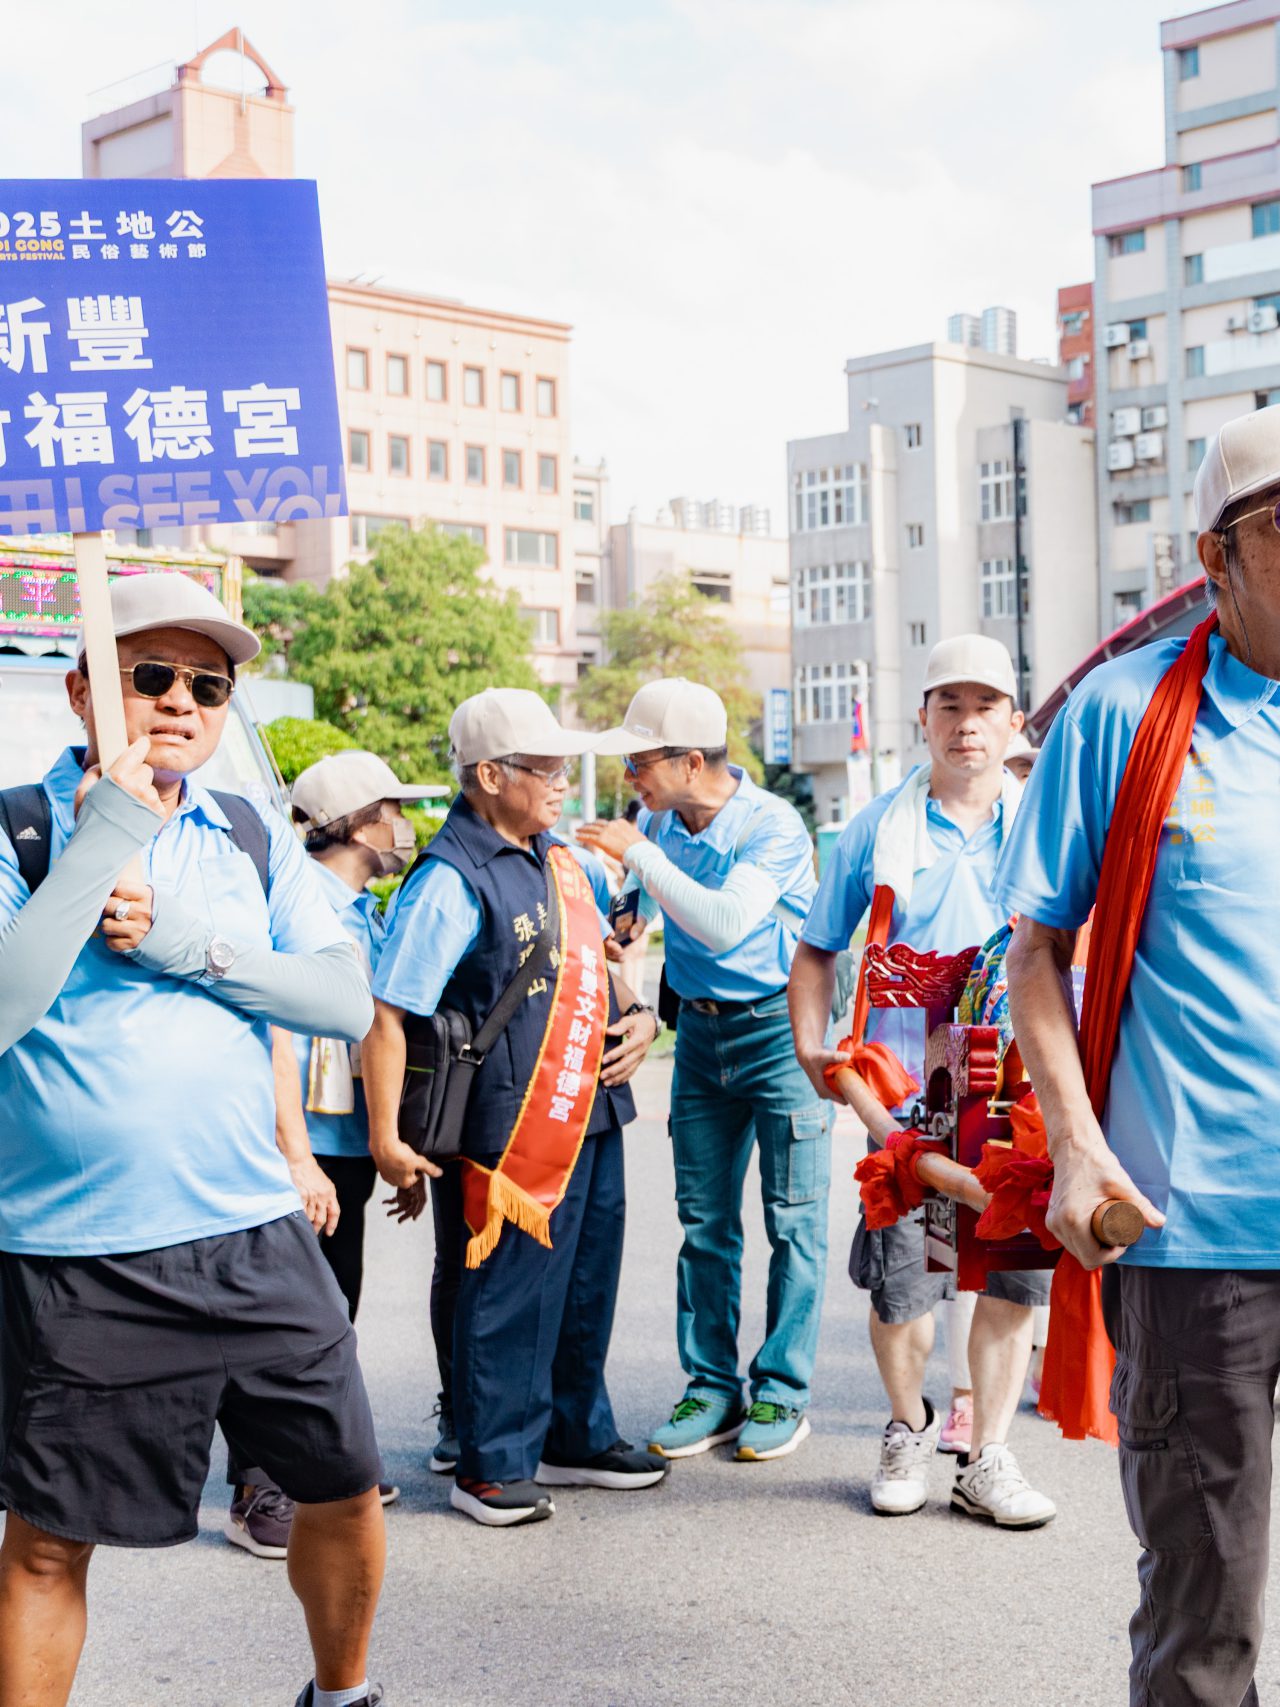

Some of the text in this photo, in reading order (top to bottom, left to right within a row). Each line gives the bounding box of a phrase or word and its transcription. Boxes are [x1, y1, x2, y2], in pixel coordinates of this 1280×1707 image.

[69, 210, 204, 239] 土地公
[15, 239, 65, 251] GONG
[72, 243, 207, 260] 民俗藝術節
[0, 383, 301, 468] 福德宮
[20, 576, 57, 615] 平
[1187, 775, 1216, 843] 土地公
